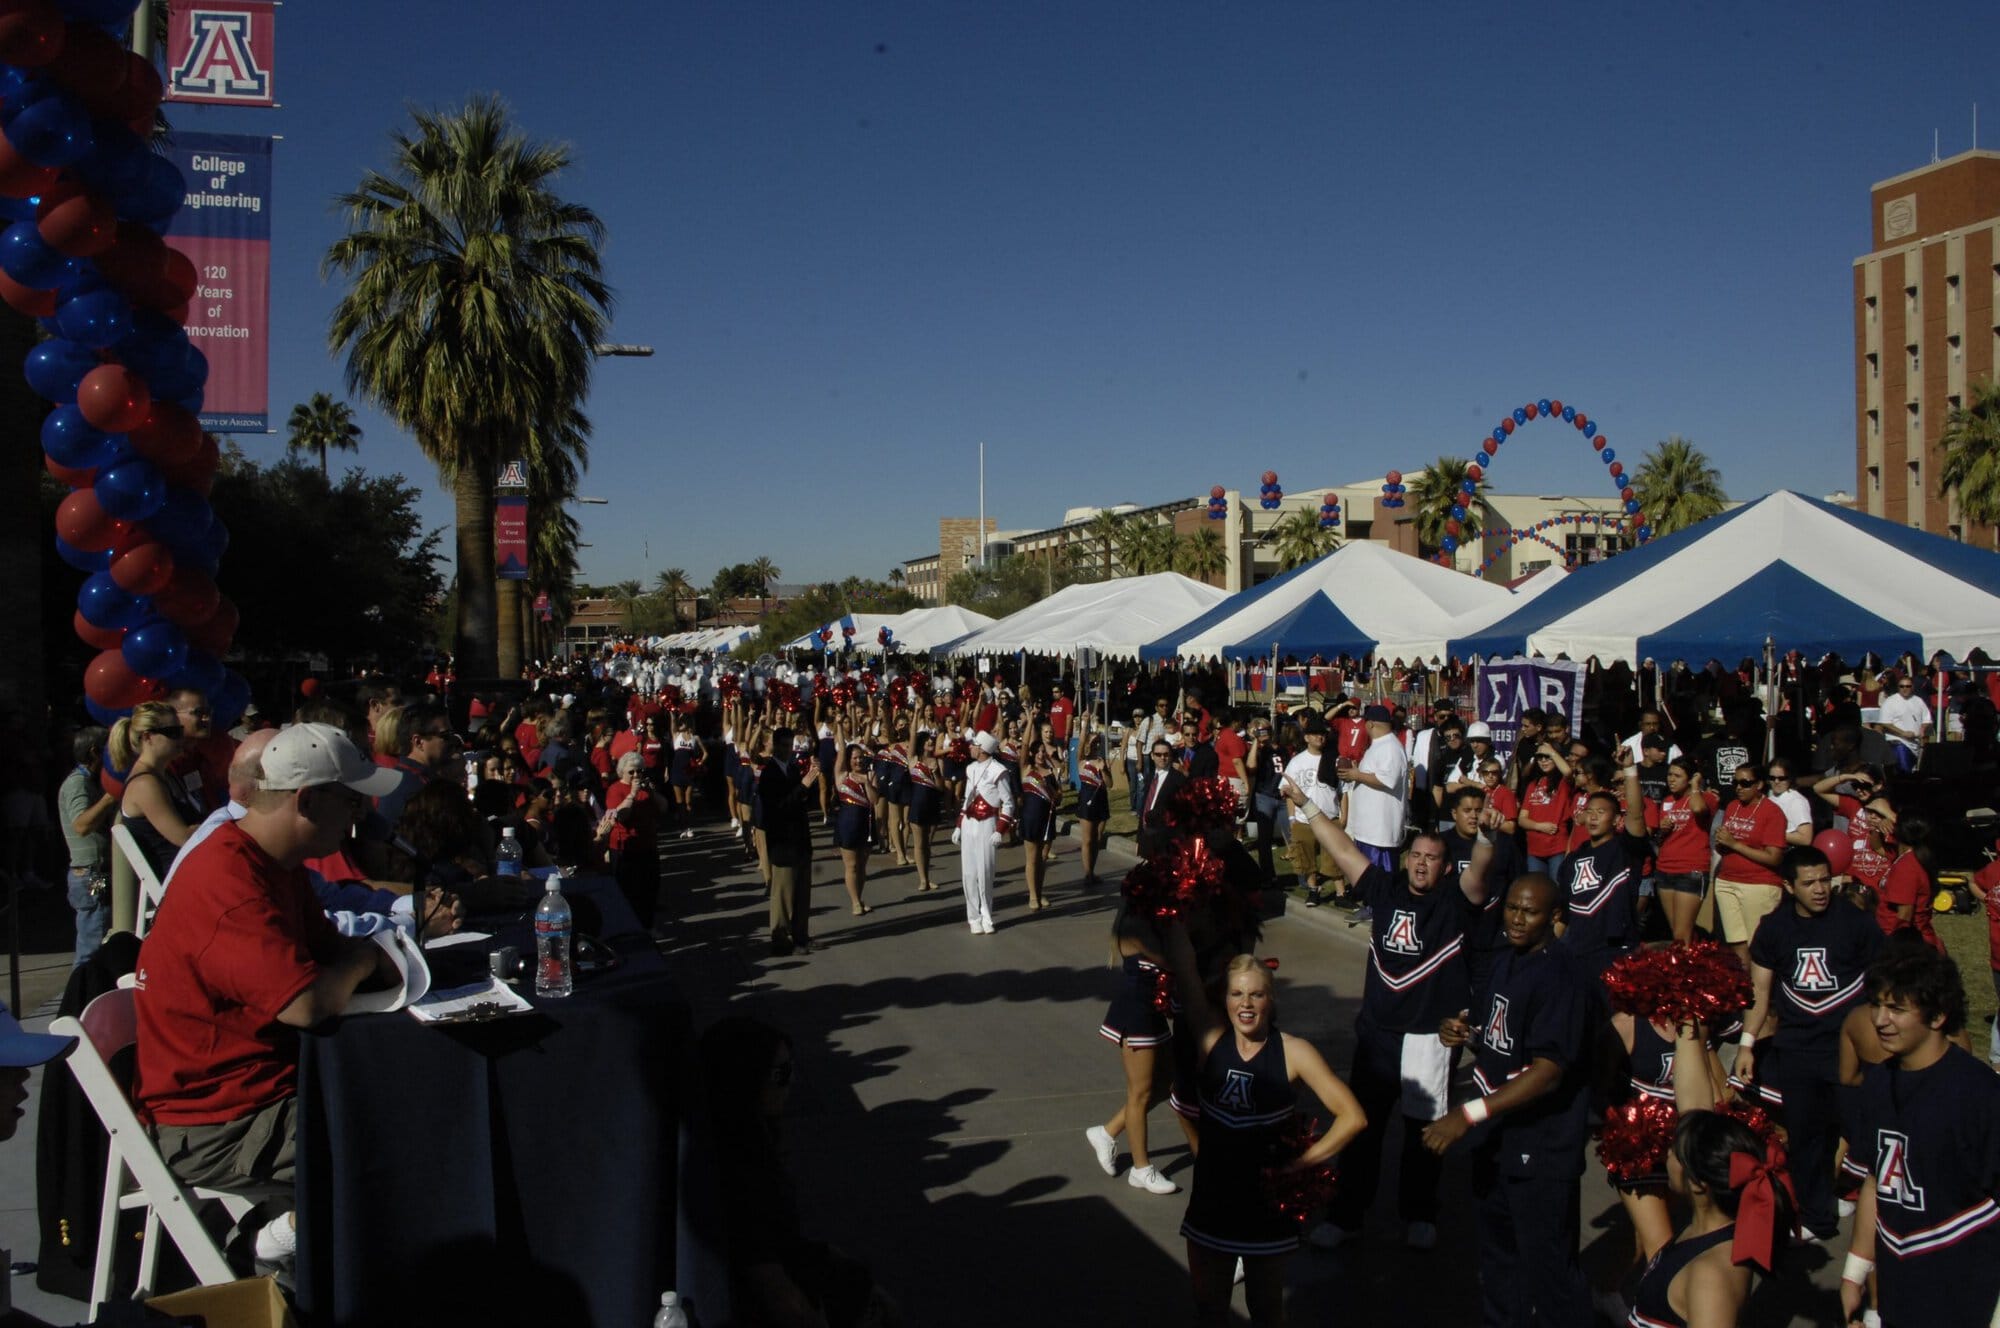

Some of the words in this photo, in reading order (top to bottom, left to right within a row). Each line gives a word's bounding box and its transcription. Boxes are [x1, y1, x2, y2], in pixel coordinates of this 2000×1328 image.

[171, 9, 270, 100] A
[191, 154, 246, 177] College
[210, 174, 227, 190] of
[183, 191, 261, 212] ngineering
[203, 265, 228, 280] 120
[196, 284, 233, 300] Years
[207, 304, 222, 319] of
[182, 324, 249, 339] nnovation
[497, 460, 528, 487] A
[1351, 728, 1360, 747] 7
[1571, 855, 1603, 895] A
[1382, 909, 1423, 956] A
[1792, 947, 1839, 991] A
[1483, 993, 1514, 1056] A
[1216, 1068, 1257, 1115] A
[1875, 1128, 1926, 1212] A
